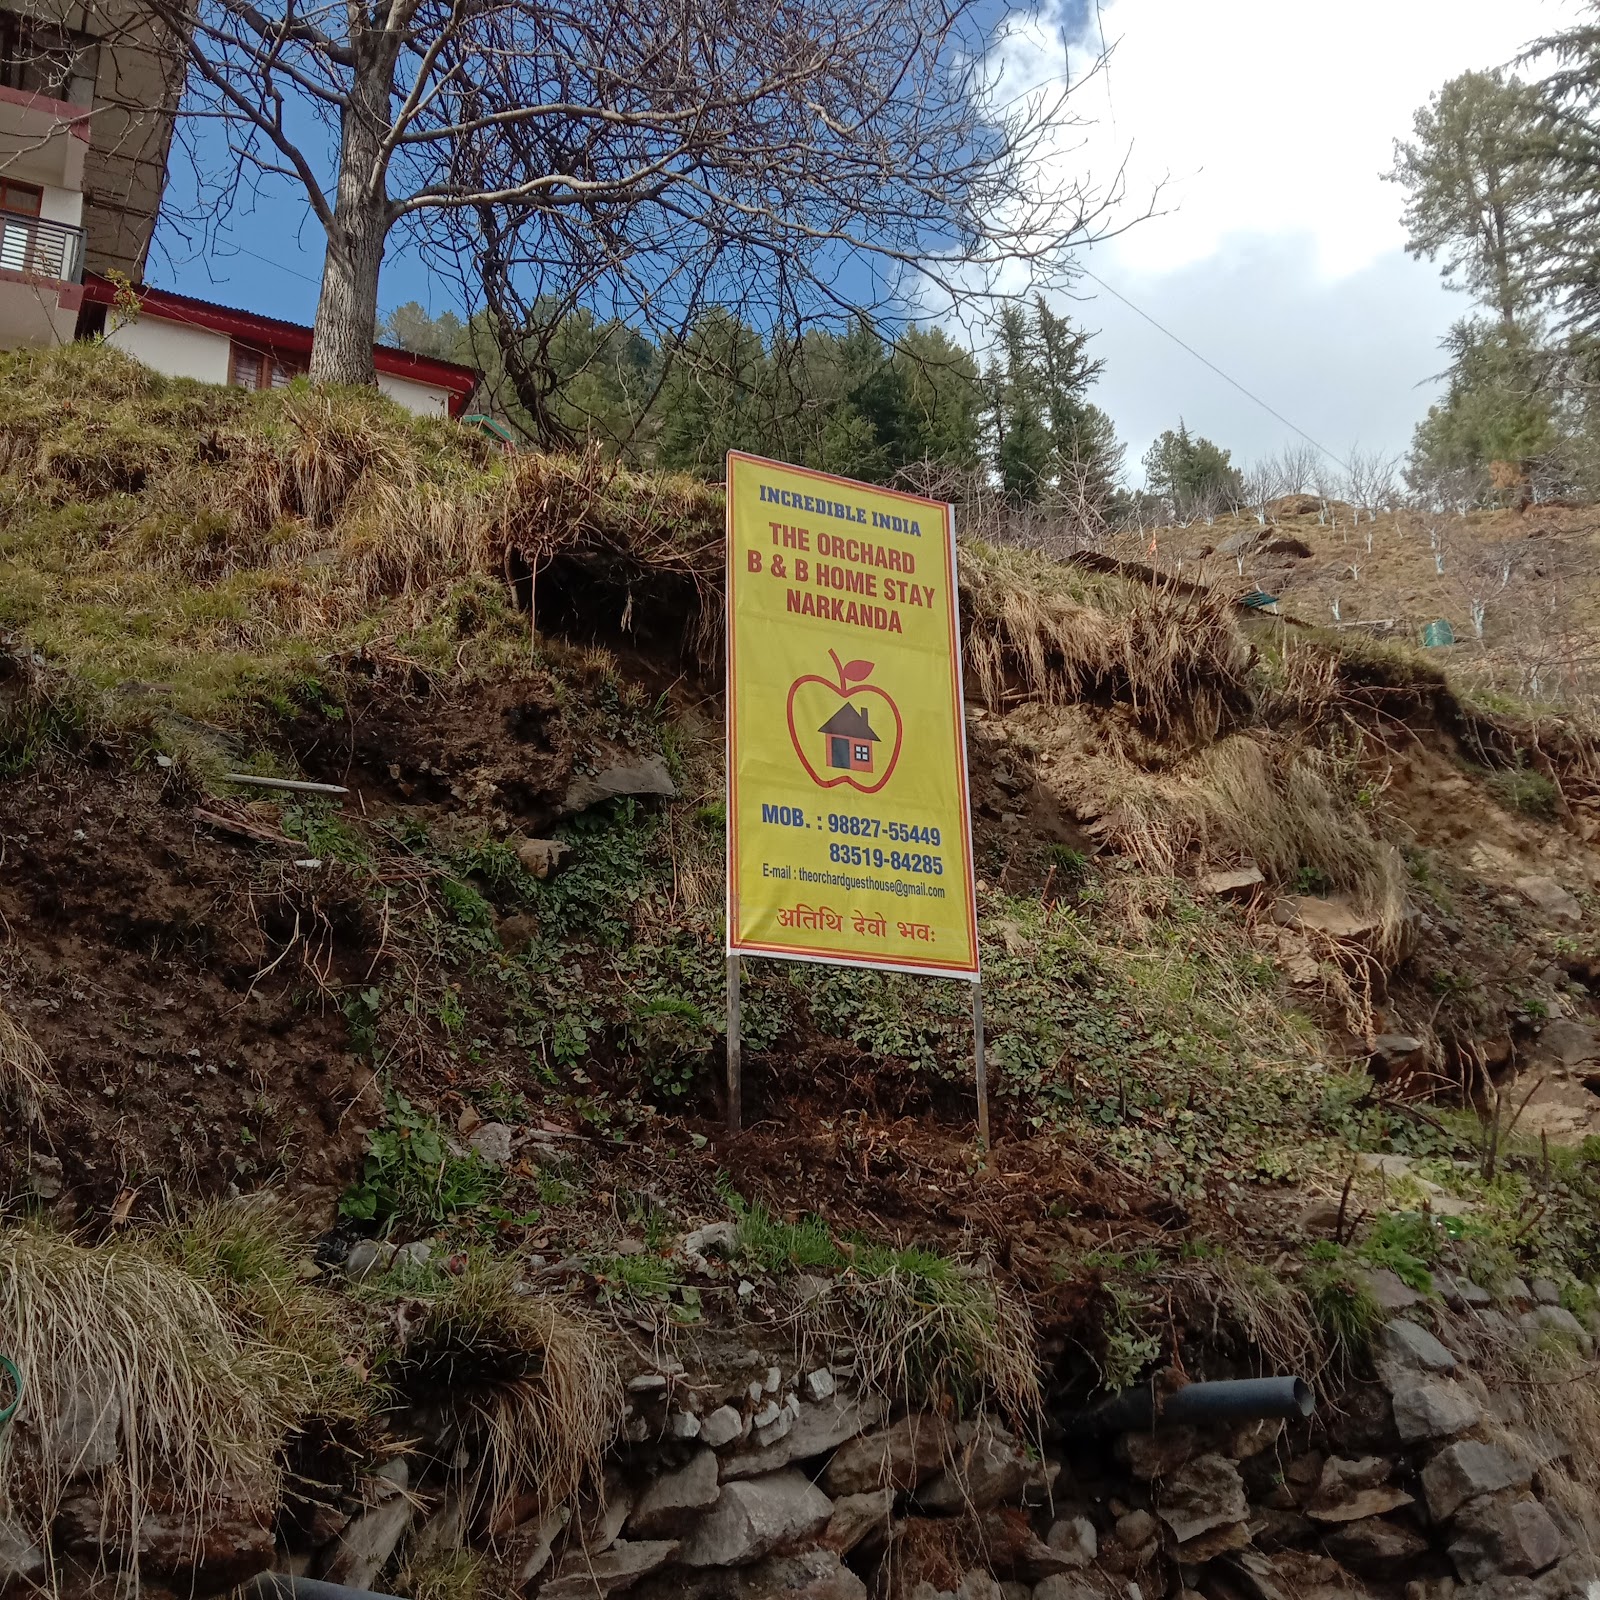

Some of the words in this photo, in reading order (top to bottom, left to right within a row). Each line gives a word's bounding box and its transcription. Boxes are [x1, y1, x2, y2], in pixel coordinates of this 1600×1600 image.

[759, 484, 867, 525] INCREDIBLE
[872, 511, 922, 537] INDIA
[769, 521, 811, 552] THE
[817, 532, 916, 575] ORCHARD
[747, 549, 763, 574] B
[770, 553, 787, 579] &
[795, 558, 809, 582] B
[816, 562, 878, 598] HOME
[883, 577, 936, 609] STAY
[786, 588, 903, 634] NARKANDA
[761, 803, 811, 829] MOB.
[827, 813, 942, 847] 98827-55449
[762, 862, 792, 880] E-mail
[799, 866, 946, 899] theorchardguesthouse@gmail.com
[829, 842, 944, 876] 83519-84285
[776, 903, 844, 933] अतिथि
[850, 909, 888, 938] देवो
